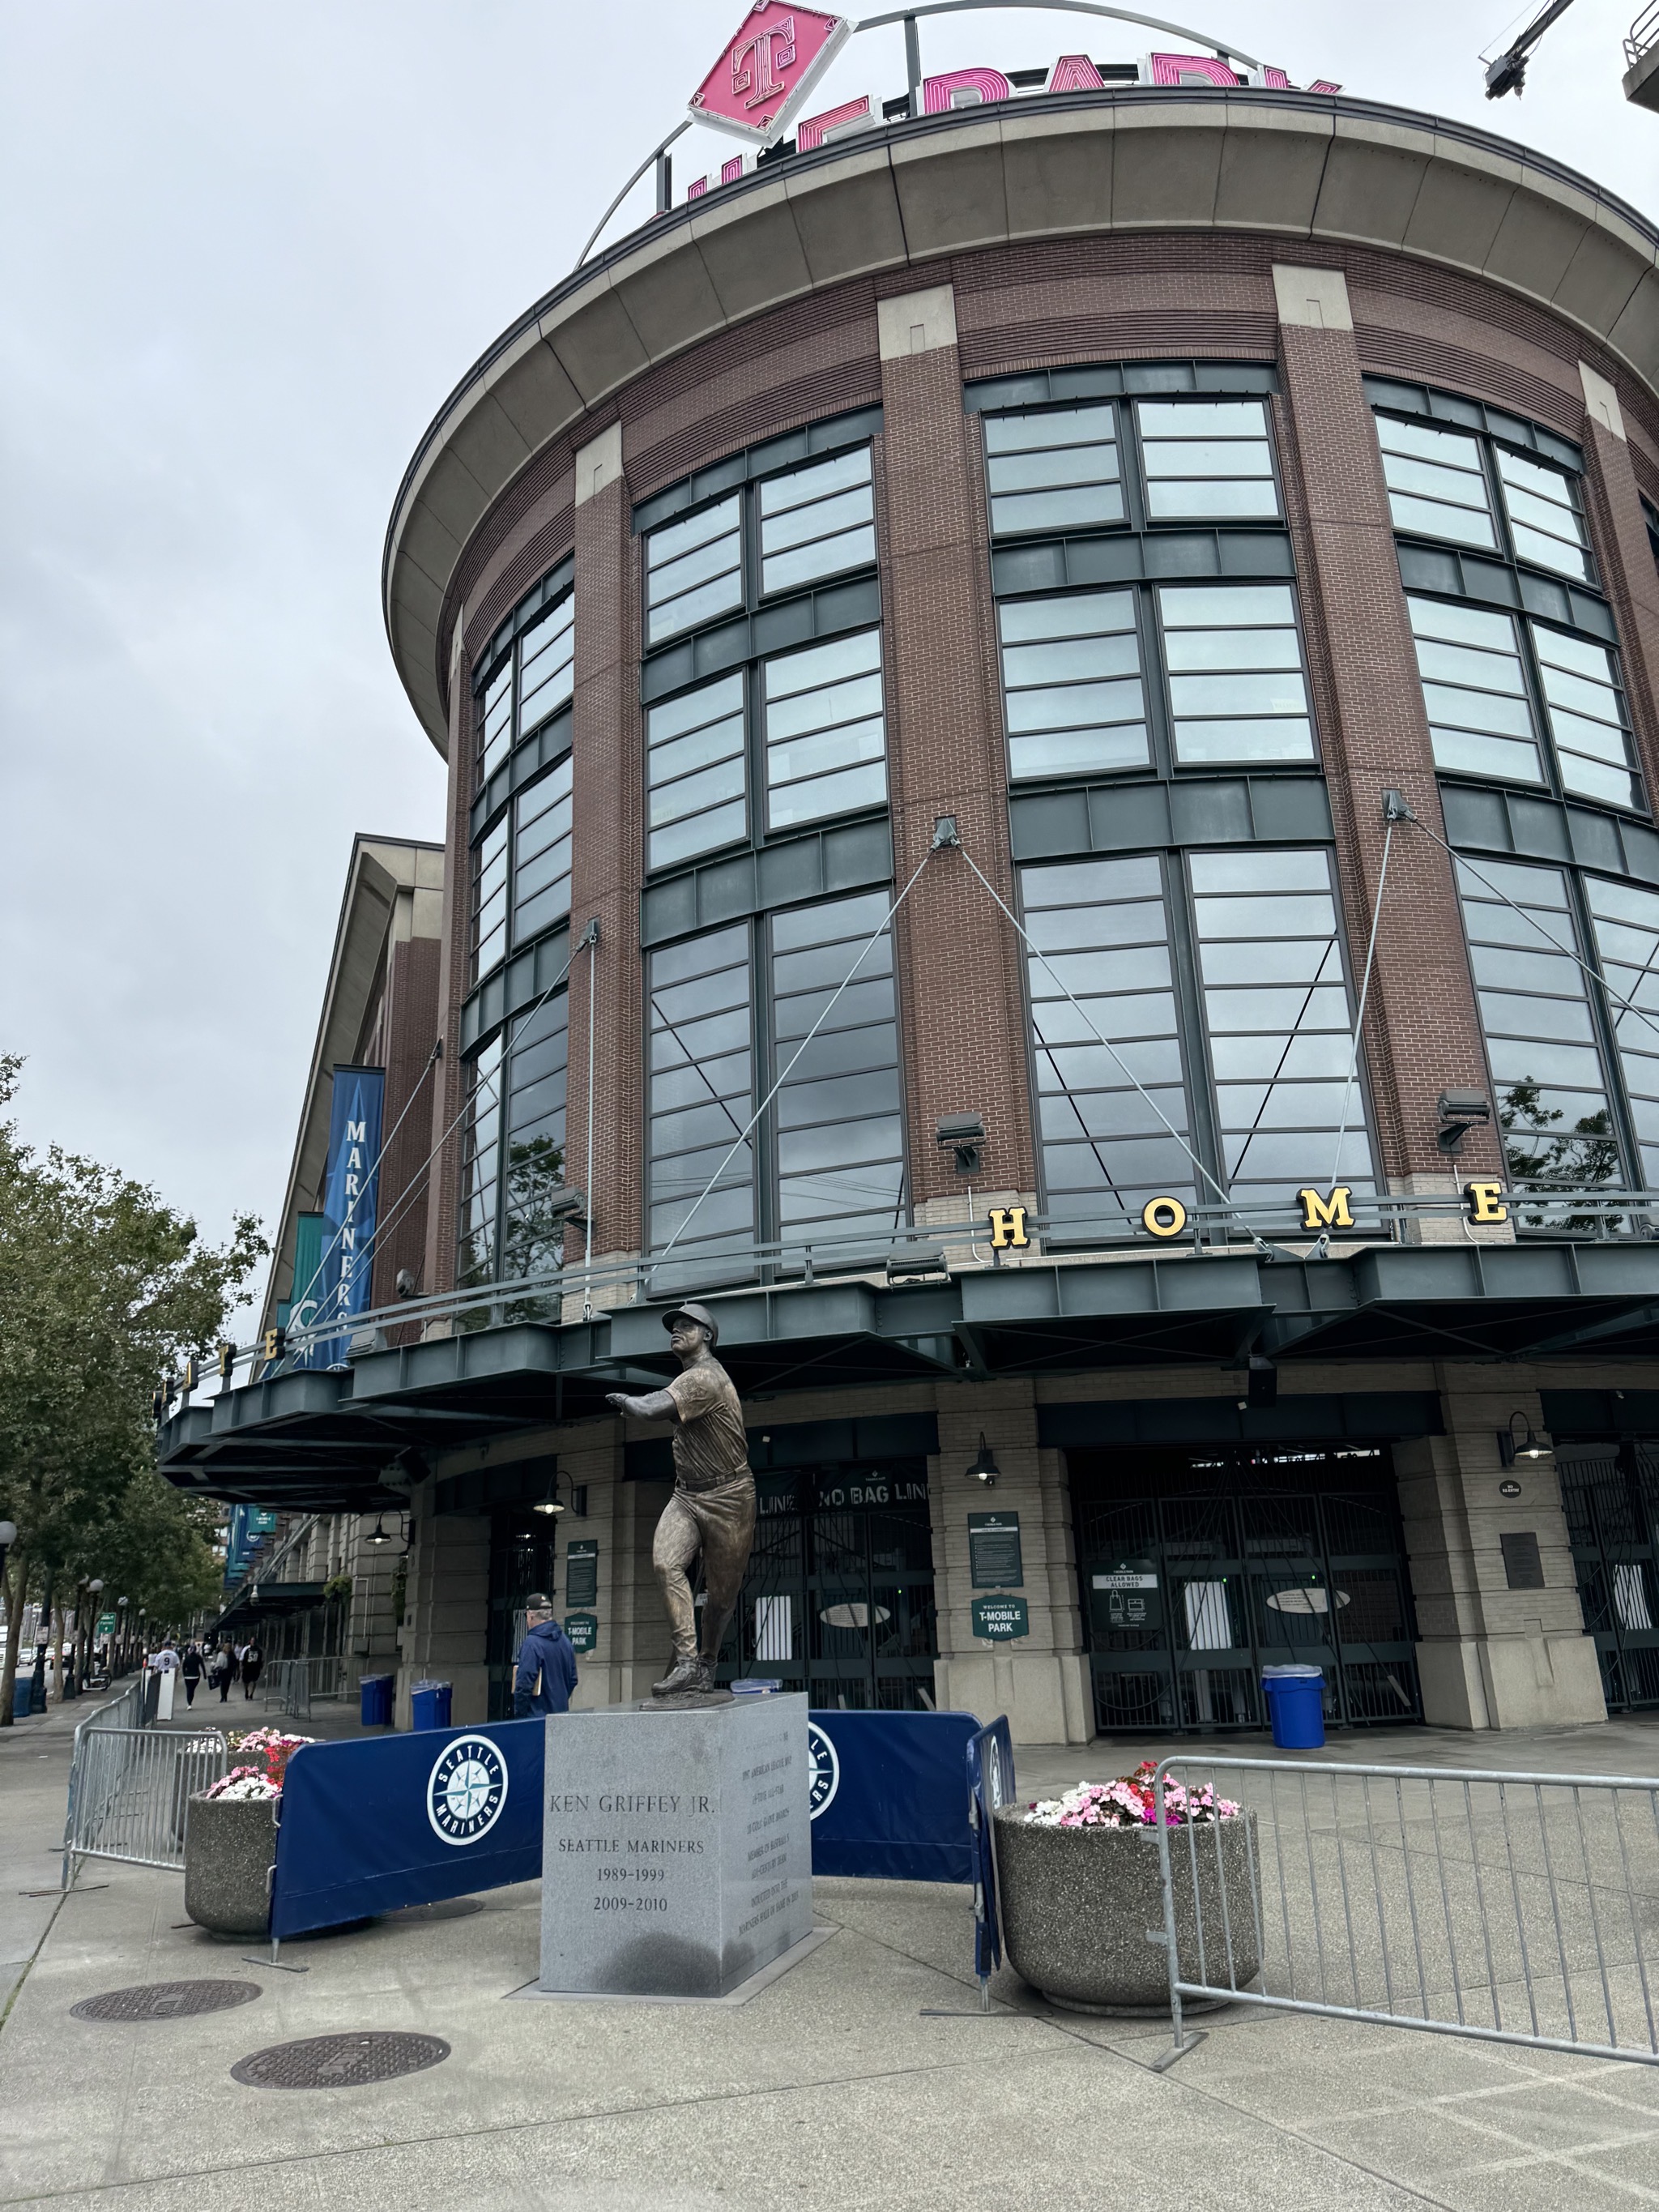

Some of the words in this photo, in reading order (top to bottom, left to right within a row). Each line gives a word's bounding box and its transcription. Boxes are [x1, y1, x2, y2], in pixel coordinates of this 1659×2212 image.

[988, 1181, 1508, 1249] HOME
[818, 1488, 845, 1507] NO
[851, 1485, 889, 1505] BAG
[894, 1483, 930, 1501] LIN
[979, 1611, 1021, 1621] T-MOBILE
[988, 1622, 1013, 1633] PARK
[164, 1657, 170, 1666] 9
[438, 1744, 499, 1783] SEATTLE
[550, 1796, 589, 1813] KEN
[599, 1795, 680, 1813] GRIFFEY
[689, 1796, 715, 1817] JR.
[436, 1795, 499, 1835] MARINERS
[559, 1838, 620, 1852] SEATTLE
[627, 1840, 704, 1854] MARINERS
[597, 1868, 664, 1882] 1989-1999
[593, 1897, 667, 1911] 2009-2010
